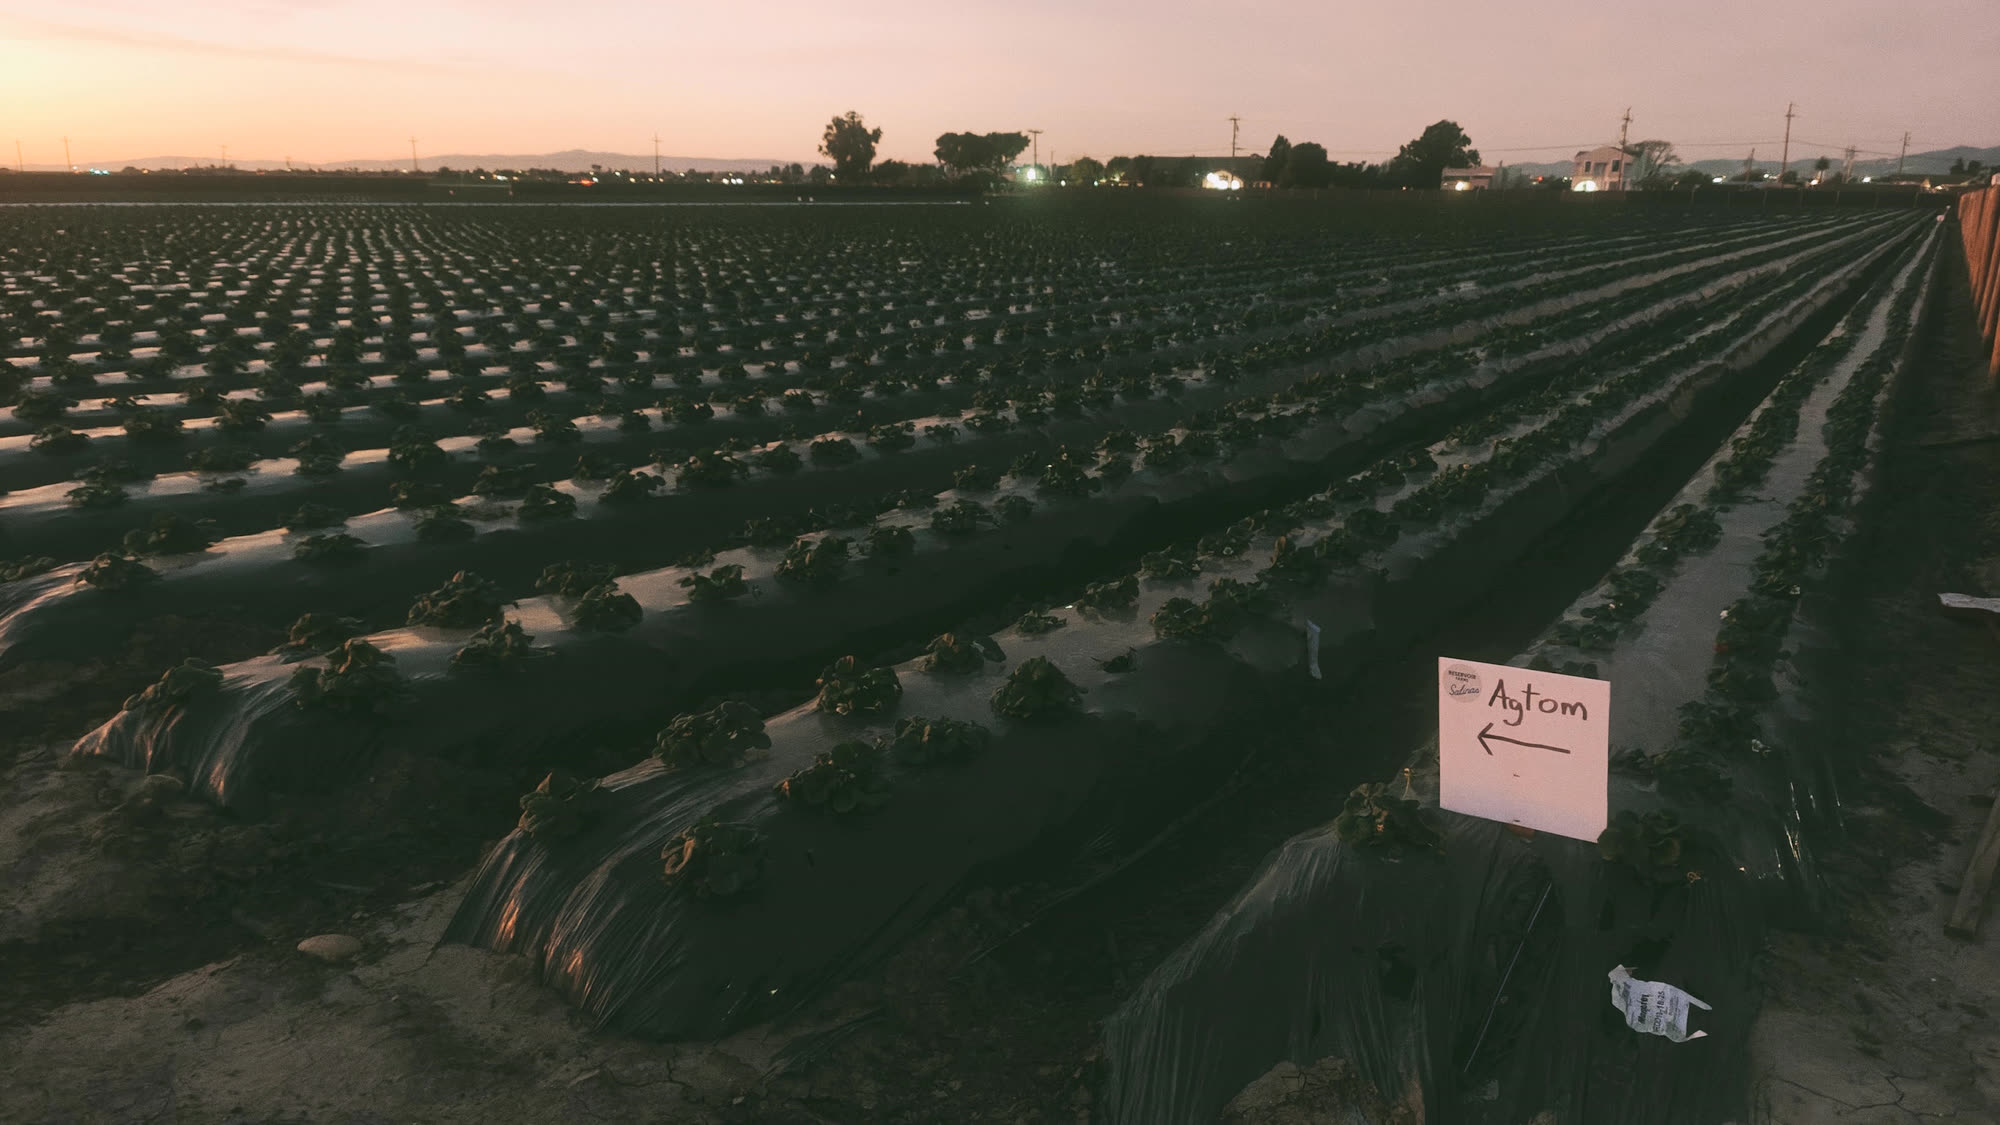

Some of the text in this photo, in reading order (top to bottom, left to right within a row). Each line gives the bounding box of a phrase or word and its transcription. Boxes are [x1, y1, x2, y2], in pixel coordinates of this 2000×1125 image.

[1448, 670, 1476, 679] RESERVOIR
[1449, 684, 1479, 696] Salinas
[1488, 678, 1587, 727] Agtom
